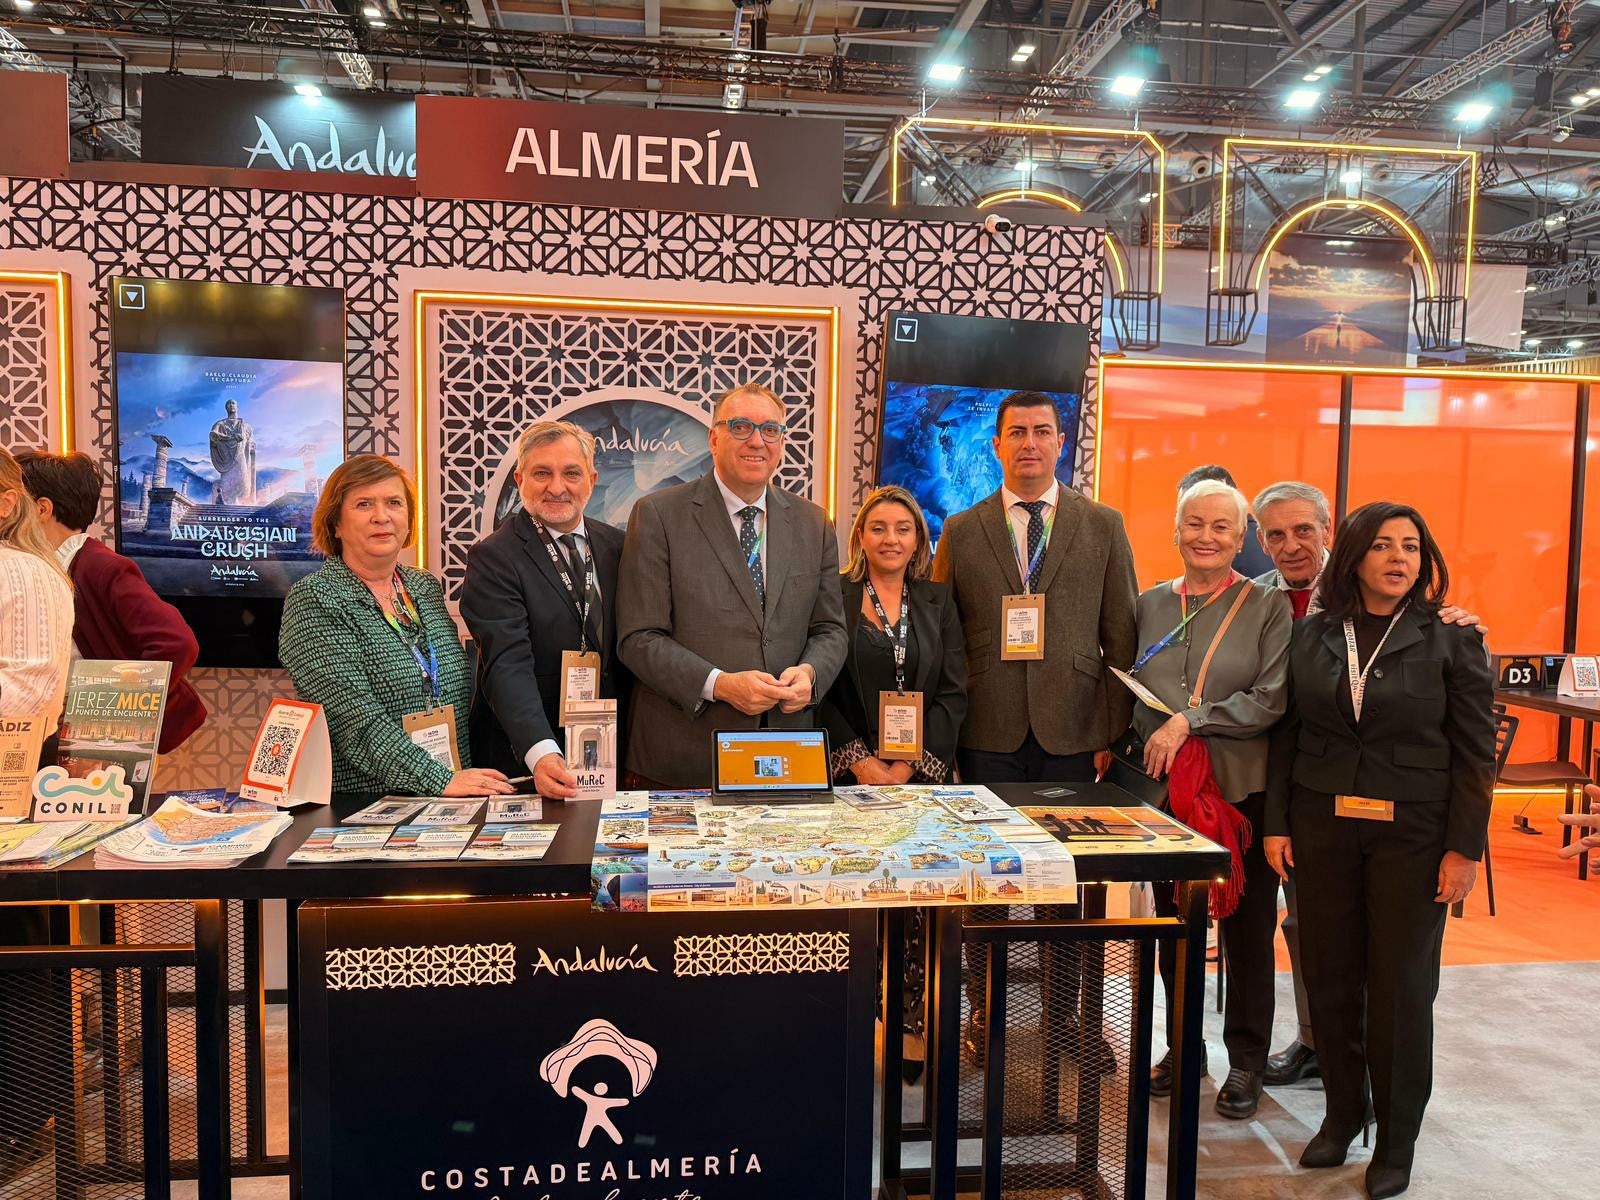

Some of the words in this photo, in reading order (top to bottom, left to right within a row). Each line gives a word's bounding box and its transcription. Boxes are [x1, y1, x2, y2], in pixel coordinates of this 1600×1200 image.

[243, 116, 416, 177] Andaluc
[505, 126, 759, 188] ALMERÍA
[230, 372, 257, 380] CLAUDIA
[594, 426, 689, 456] ndalucía
[170, 525, 298, 543] ANDALUSIAN
[200, 541, 269, 560] CRUSH
[210, 564, 259, 577] Andalucía
[1508, 667, 1532, 685] D3
[576, 774, 605, 786] MuReC
[40, 802, 107, 814] CONIL
[531, 944, 659, 976] Andalucía
